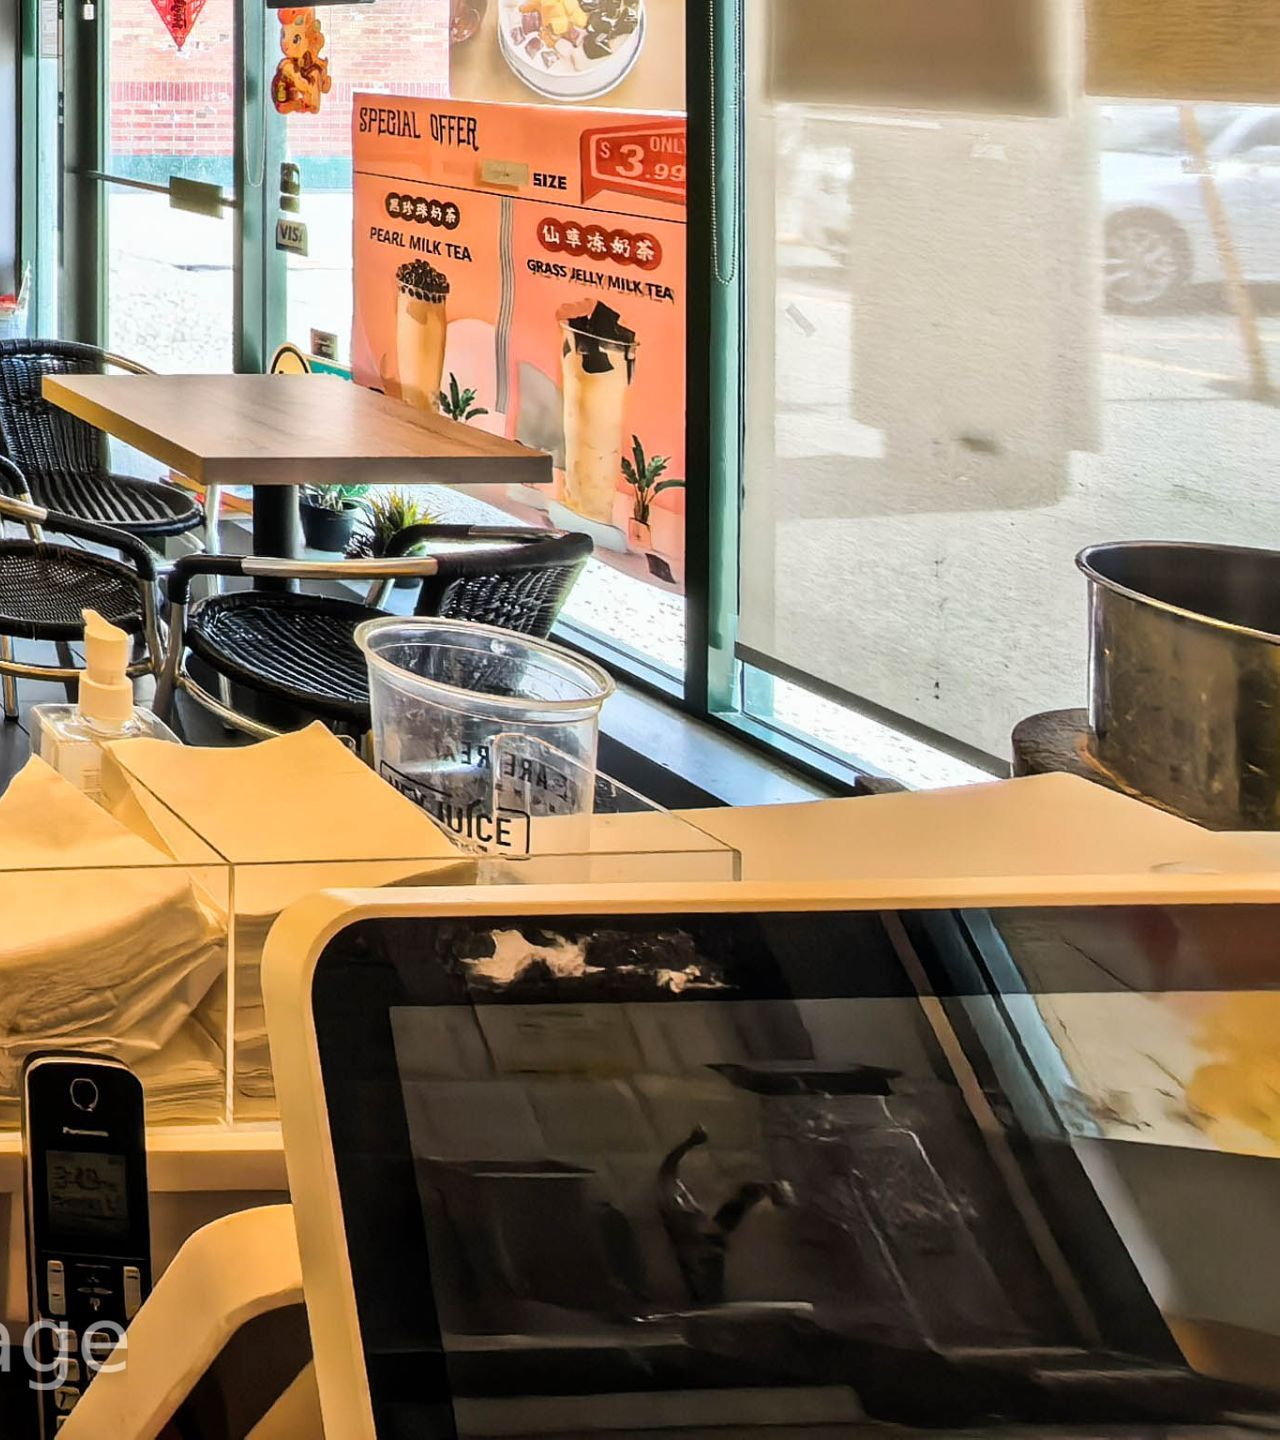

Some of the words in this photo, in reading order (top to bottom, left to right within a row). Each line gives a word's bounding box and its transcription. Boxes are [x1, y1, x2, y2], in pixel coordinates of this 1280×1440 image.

[359, 107, 421, 139] SPECIAL
[430, 113, 480, 152] OFFER
[533, 172, 567, 191] SIZE
[369, 226, 406, 248] PEARL
[409, 234, 442, 256] MILK
[445, 243, 473, 263] TEA
[526, 258, 567, 278] GRASS
[570, 267, 604, 287] JELLY
[607, 275, 643, 295] MILK
[645, 282, 676, 302] TEA
